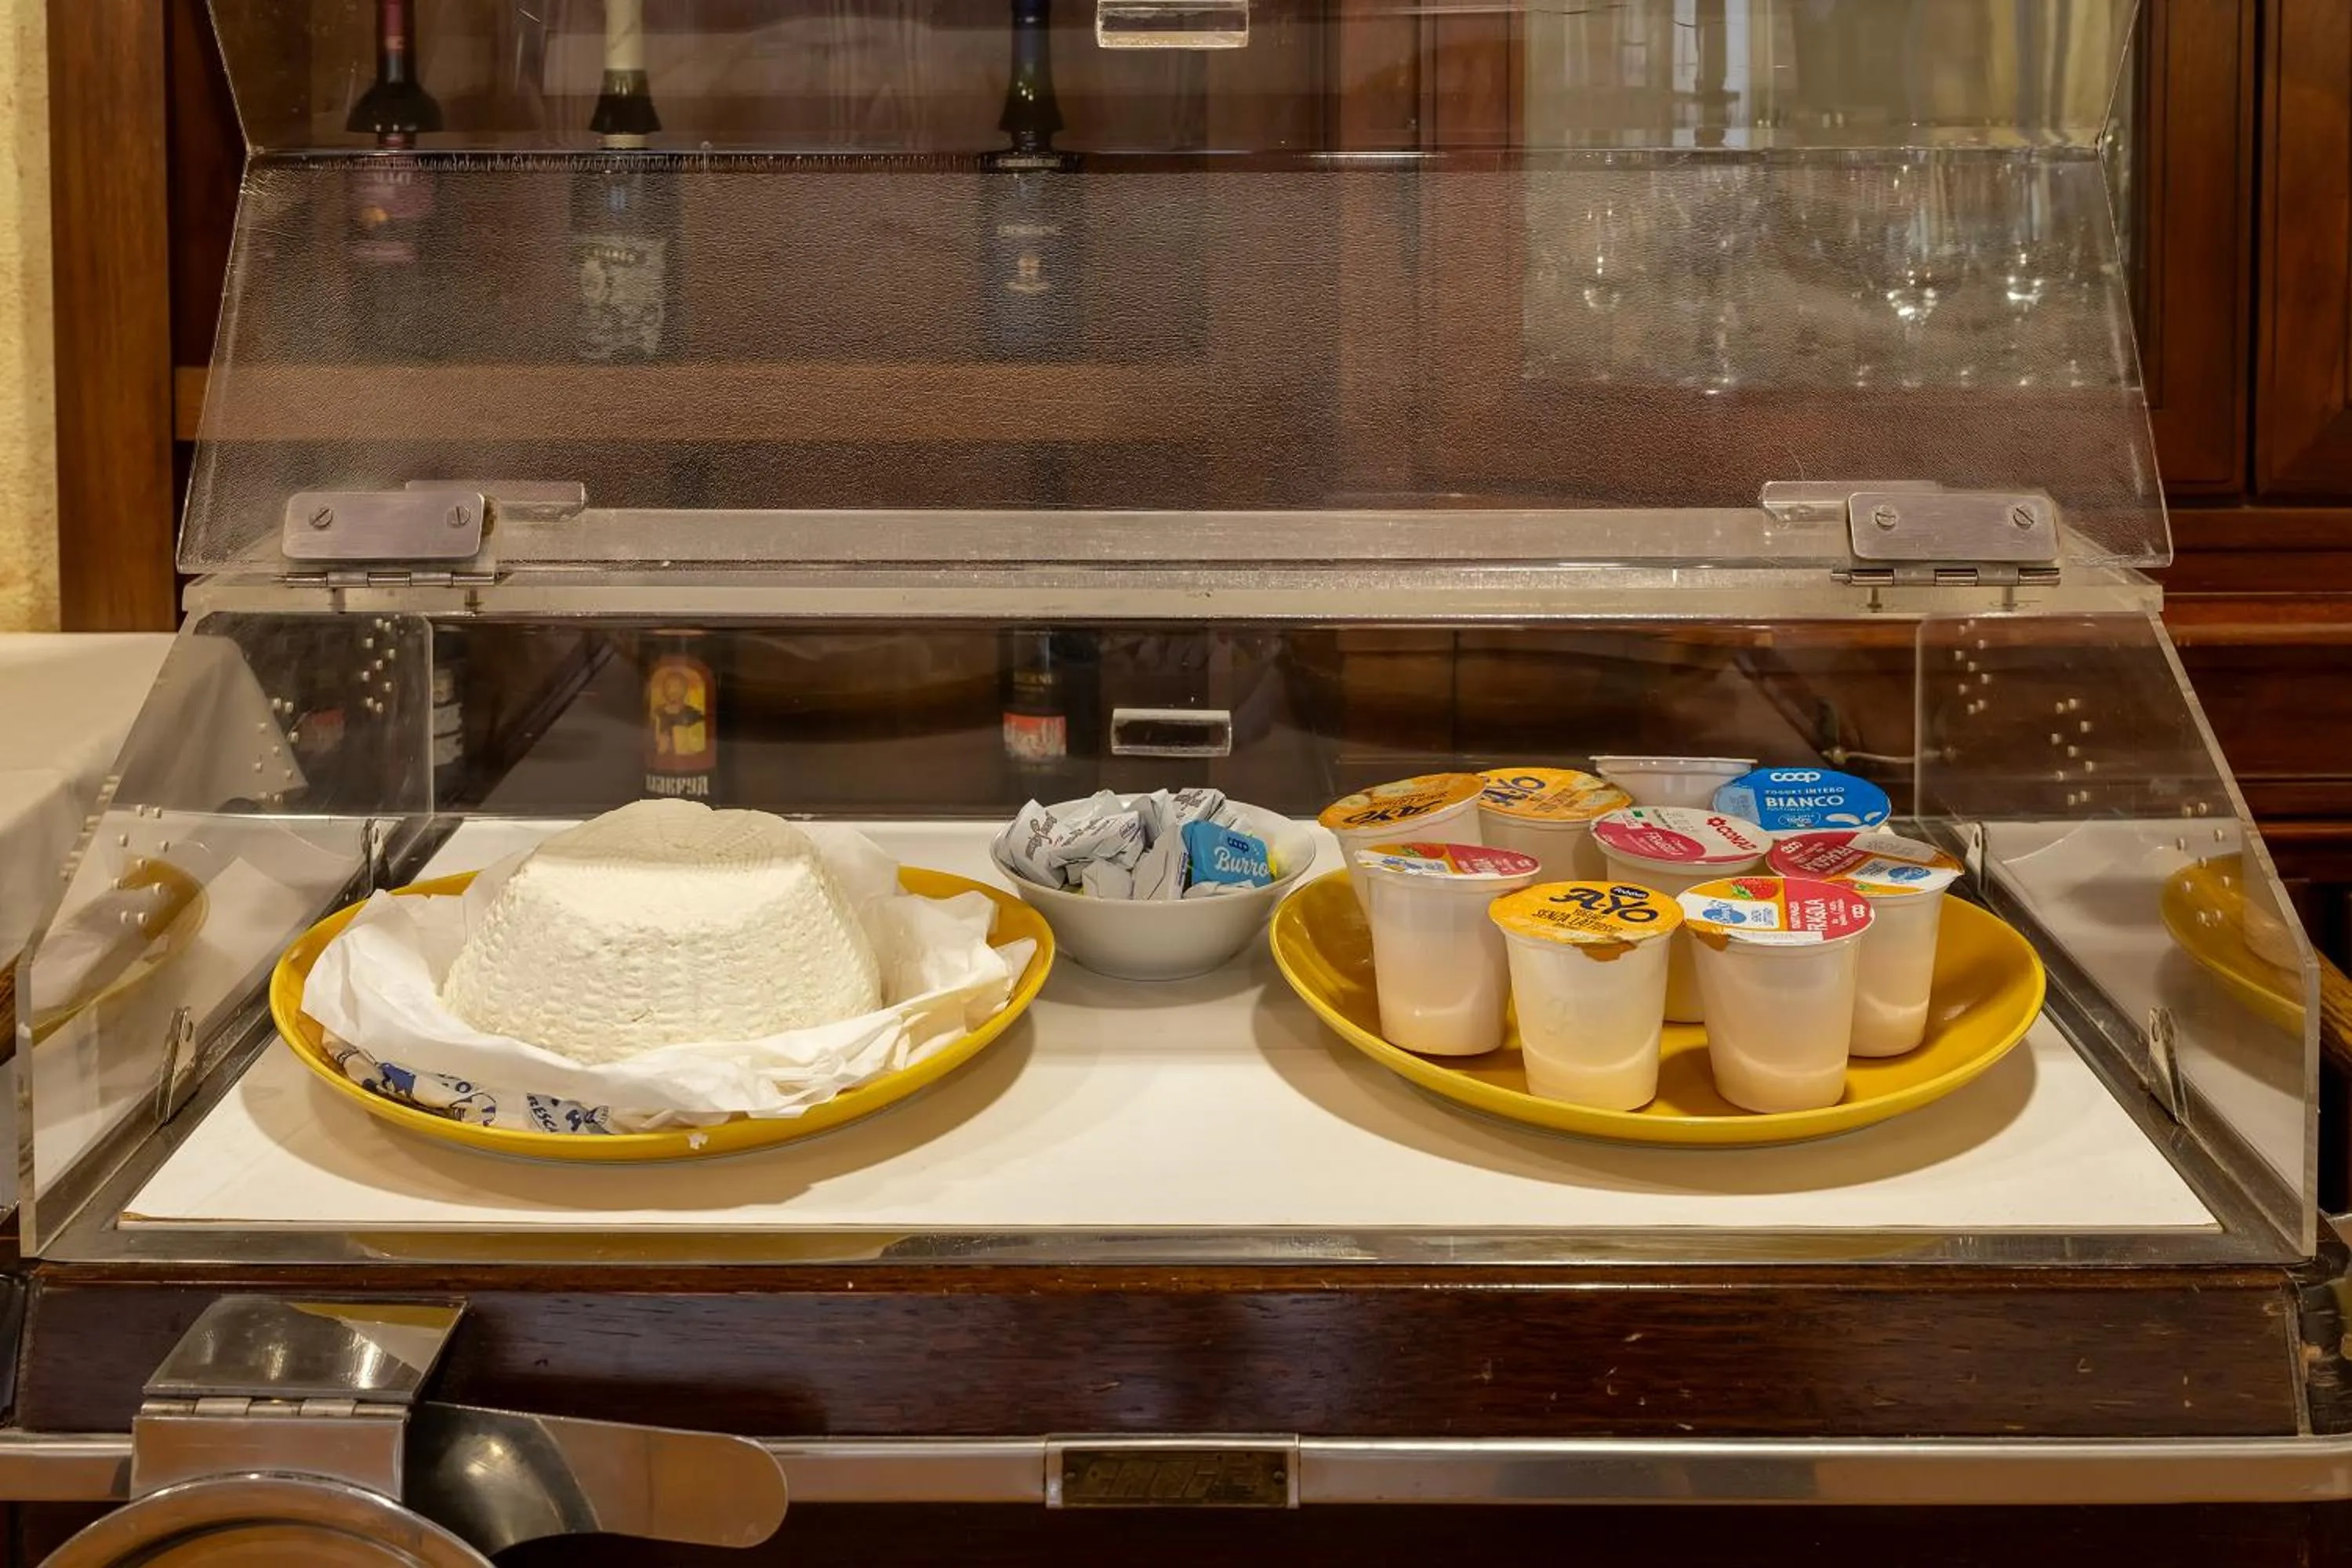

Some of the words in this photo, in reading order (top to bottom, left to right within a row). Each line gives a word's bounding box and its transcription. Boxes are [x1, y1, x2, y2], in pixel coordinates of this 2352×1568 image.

[1769, 771, 1821, 782] coop
[1766, 795, 1844, 808] BIANCO
[1227, 836, 1249, 853] coop
[1214, 847, 1269, 877] Burro
